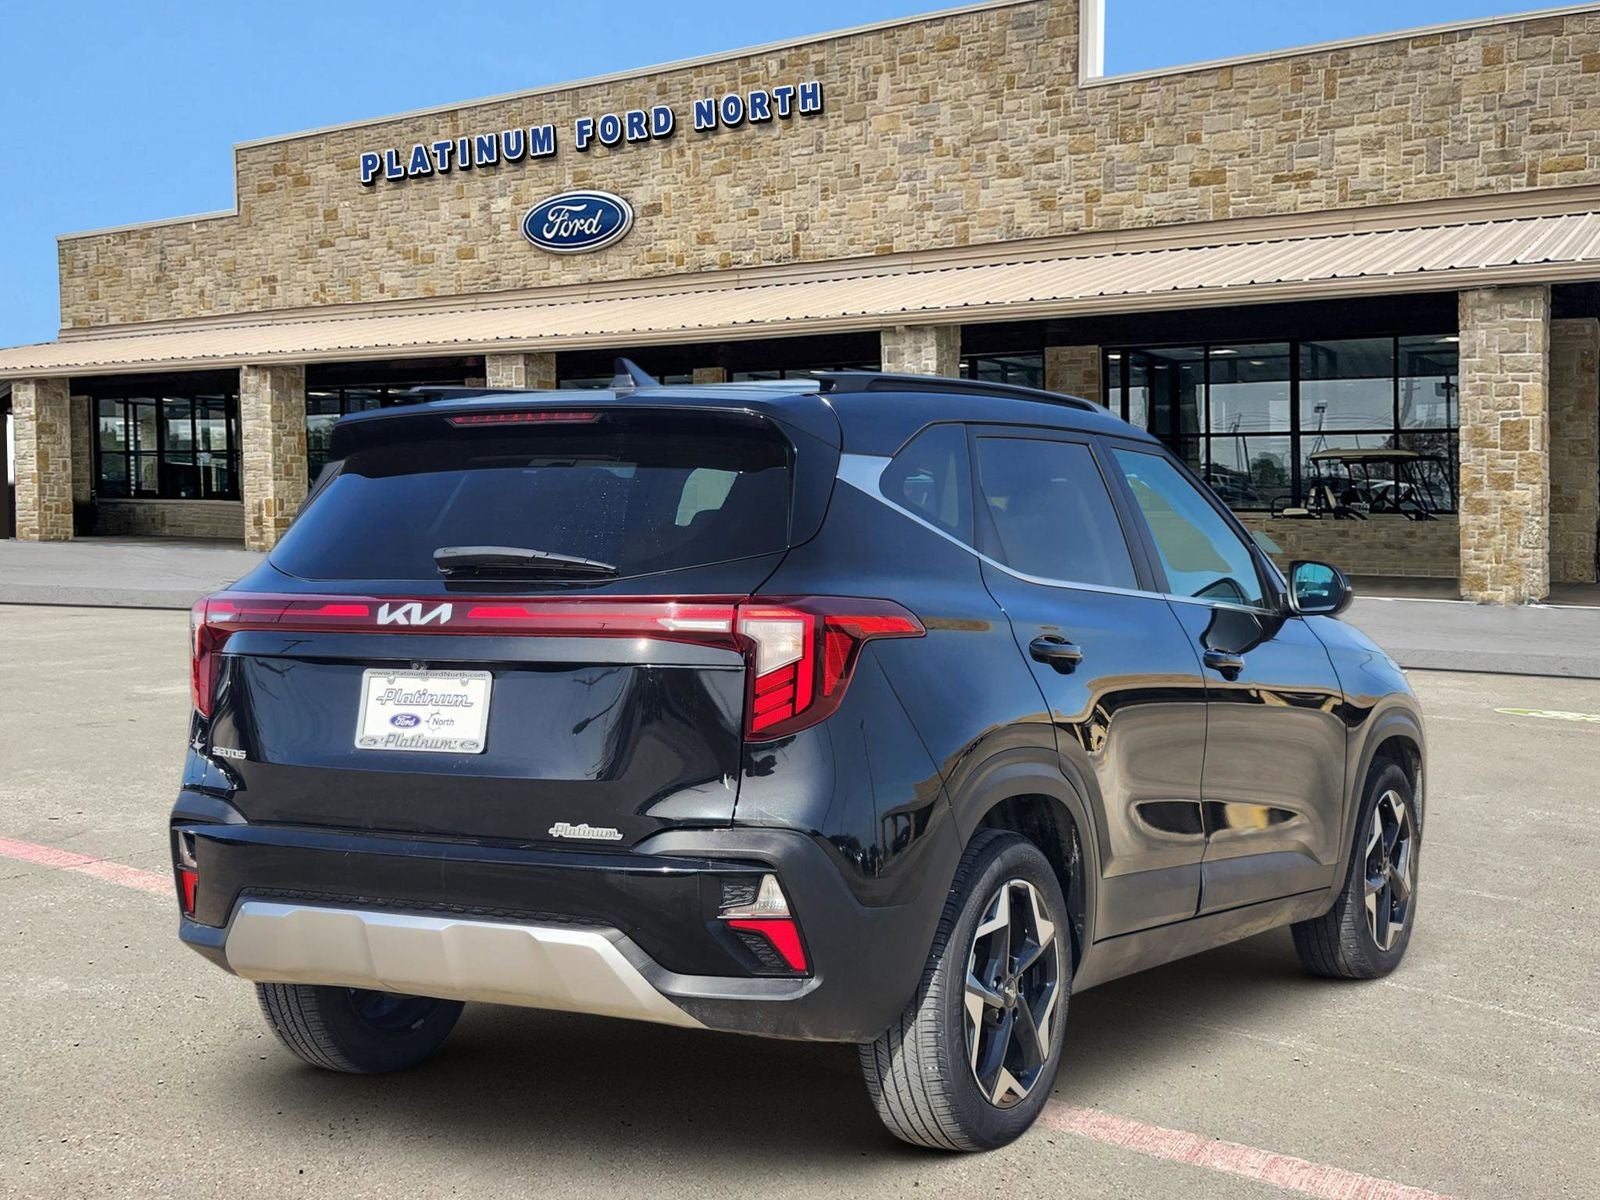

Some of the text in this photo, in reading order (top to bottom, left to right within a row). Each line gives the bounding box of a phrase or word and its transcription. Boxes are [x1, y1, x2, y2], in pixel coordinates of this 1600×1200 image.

[360, 81, 823, 185] PLATINUM FORD NORTH
[541, 203, 602, 241] Ford
[377, 602, 453, 625] KIA
[376, 688, 474, 707] Platinum
[394, 714, 454, 727] Ford North
[384, 733, 457, 750] Platinum
[548, 822, 623, 840] Platinum
